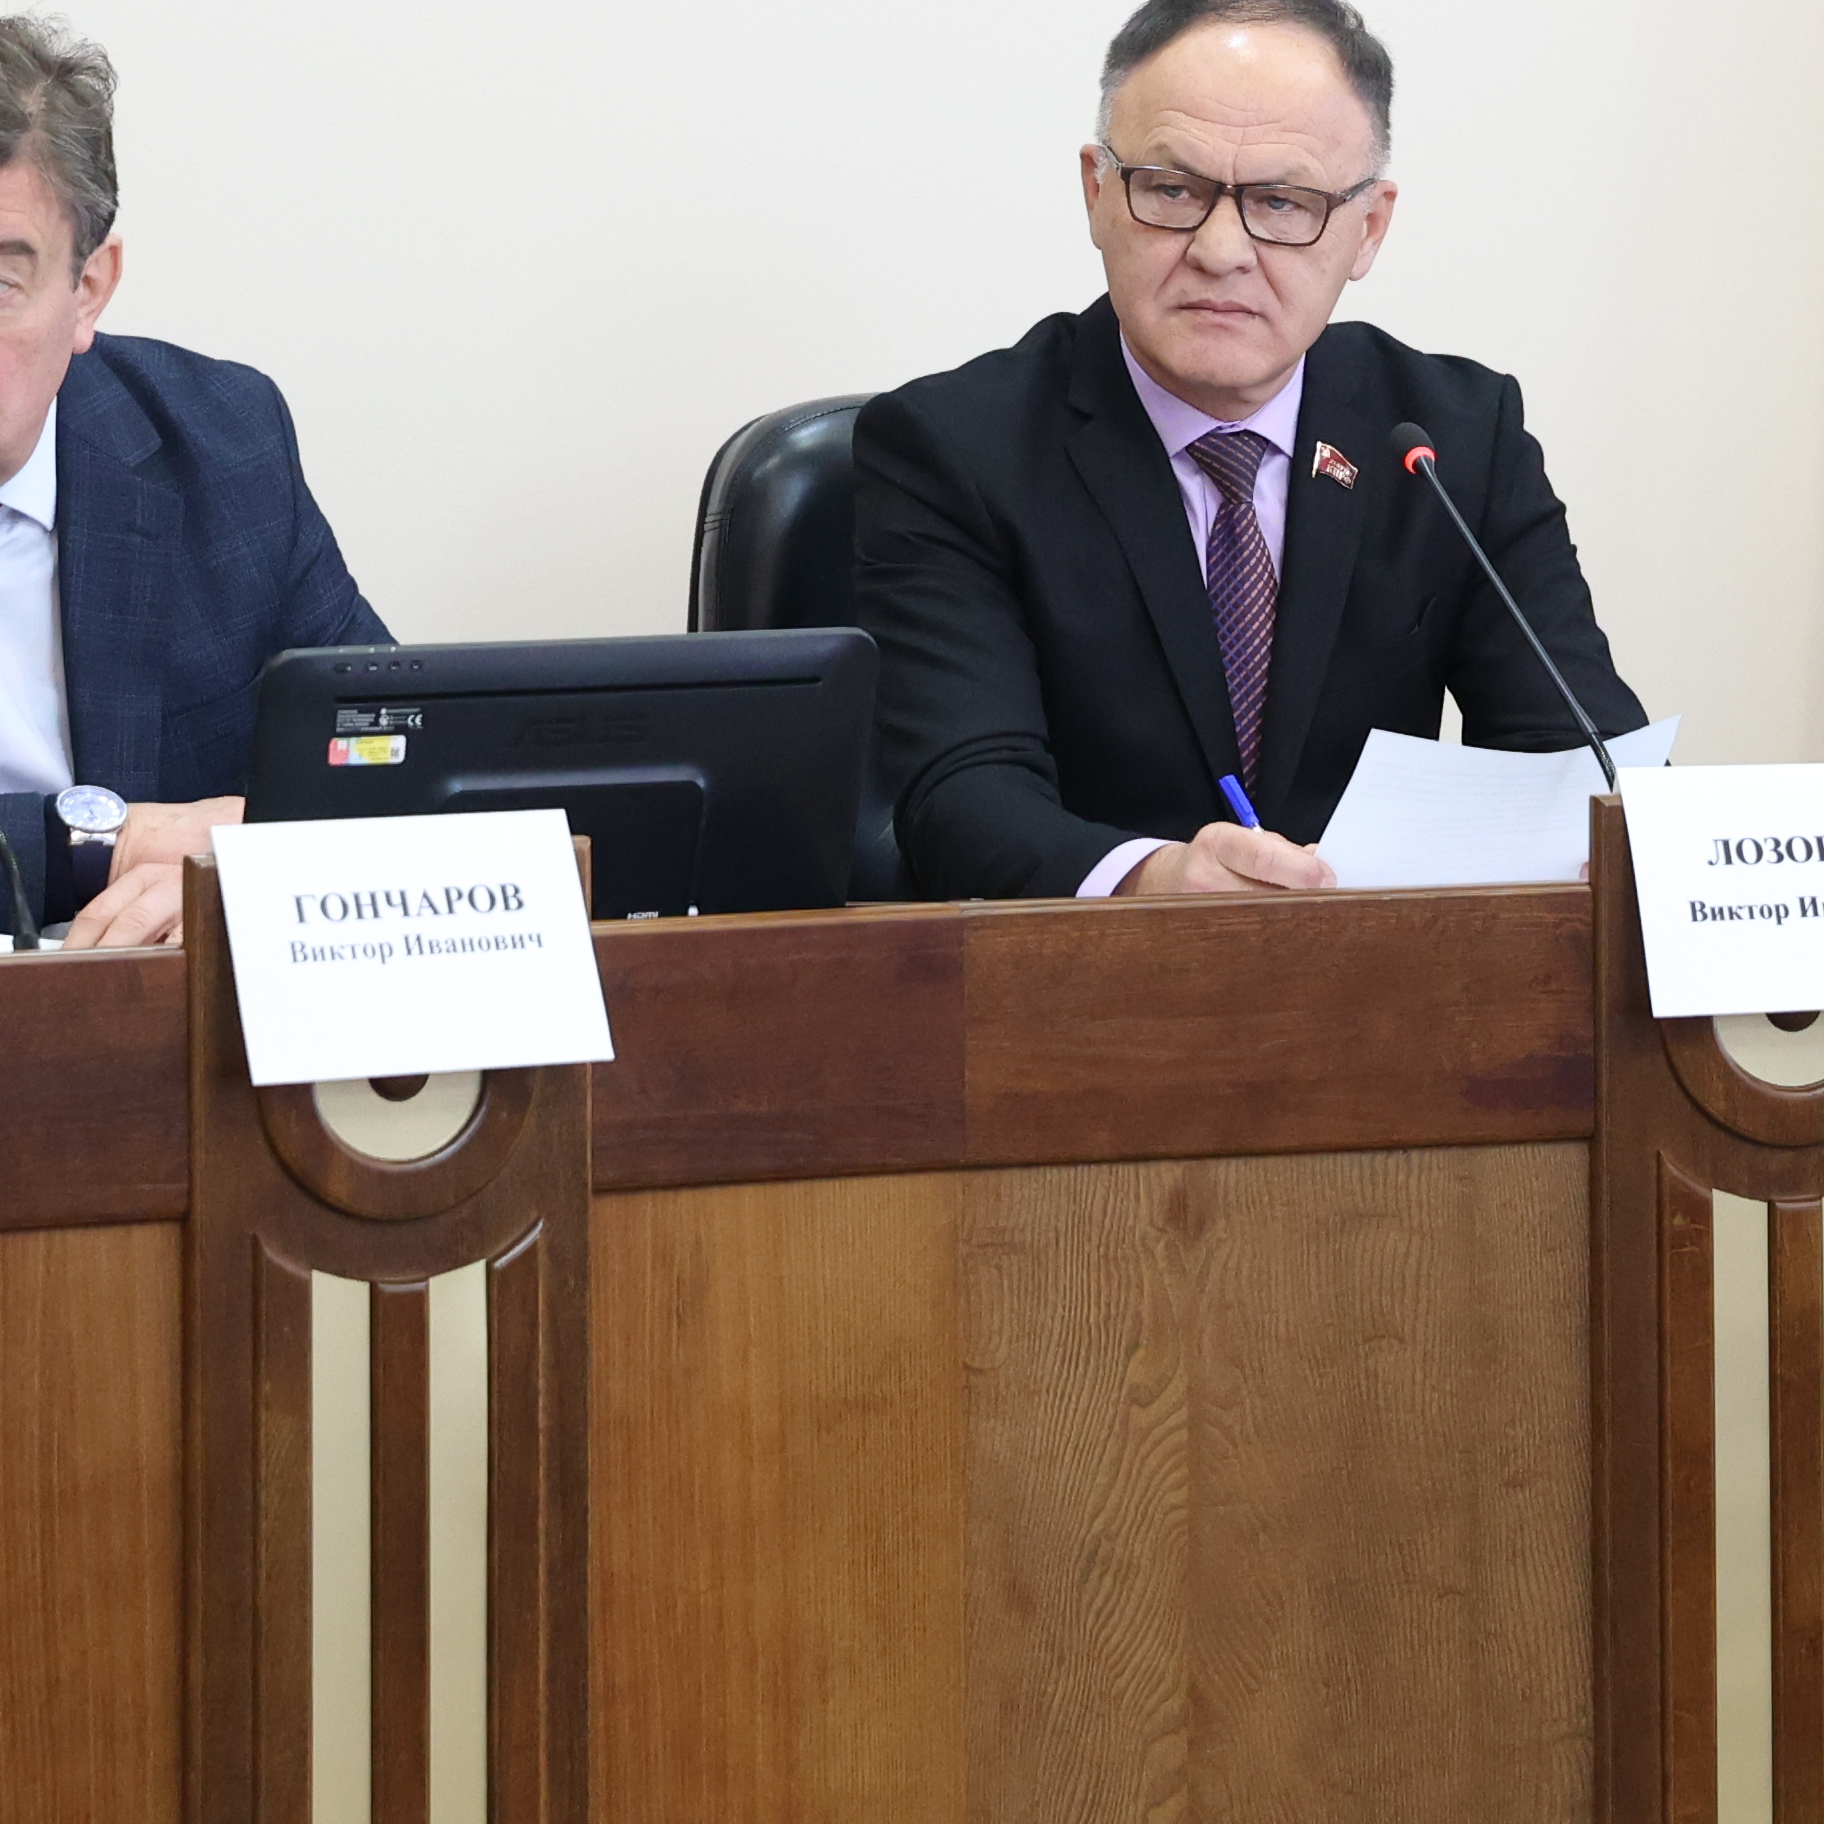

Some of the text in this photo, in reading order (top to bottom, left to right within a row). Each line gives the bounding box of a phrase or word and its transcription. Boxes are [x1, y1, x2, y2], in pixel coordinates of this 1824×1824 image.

[292, 883, 525, 924] ГОНЧАРОВ
[1689, 899, 1790, 925] Виктор
[289, 932, 545, 964] Виктор Иванович
